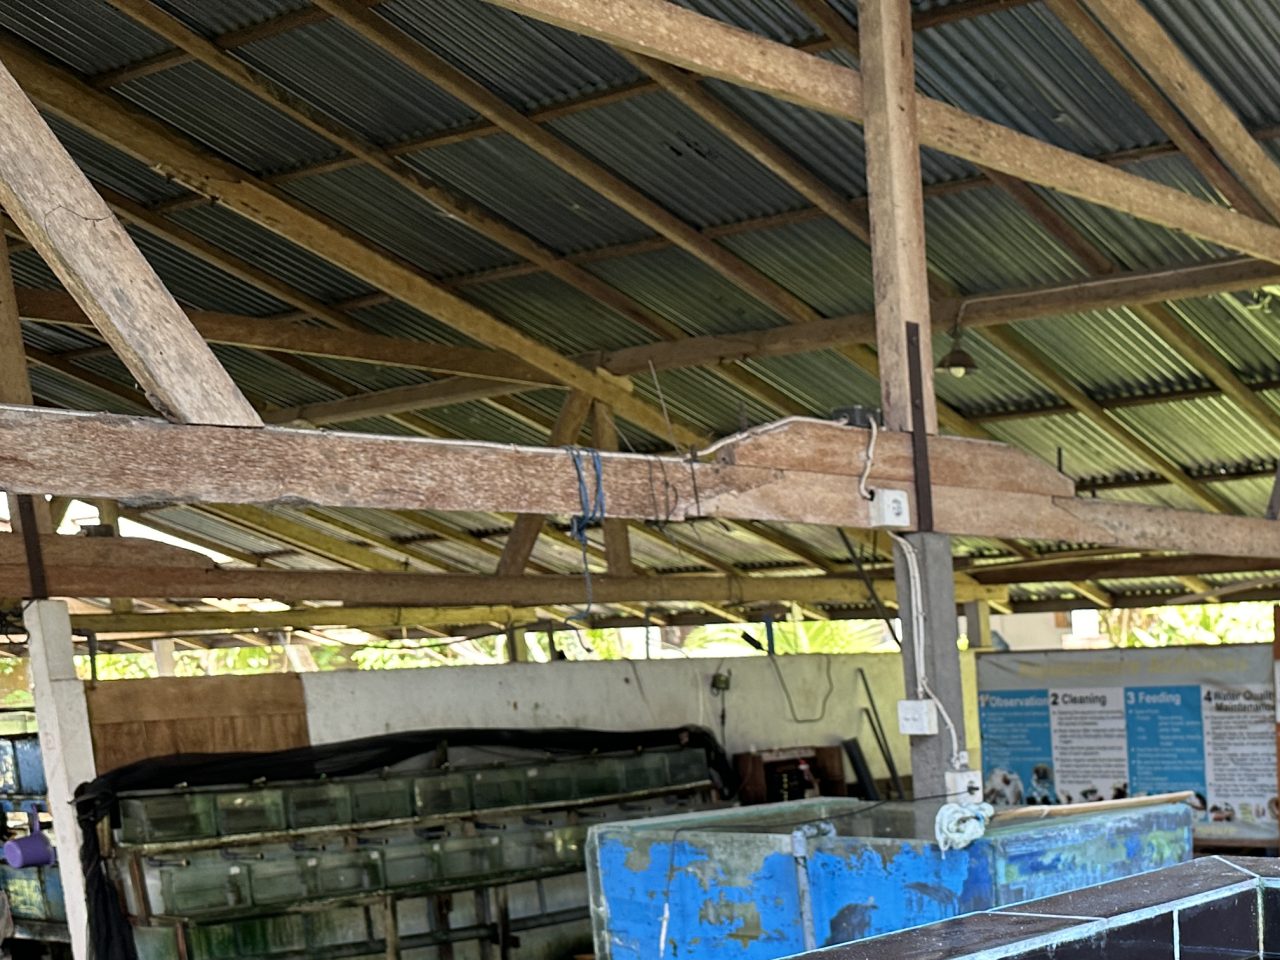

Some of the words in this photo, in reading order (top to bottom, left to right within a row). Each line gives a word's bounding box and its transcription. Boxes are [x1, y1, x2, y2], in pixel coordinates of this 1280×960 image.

[1051, 692, 1059, 706] 2
[1061, 692, 1107, 707] Cleaning
[1127, 691, 1136, 705] 3
[1138, 691, 1182, 706] Feeding
[1204, 689, 1213, 702] 4
